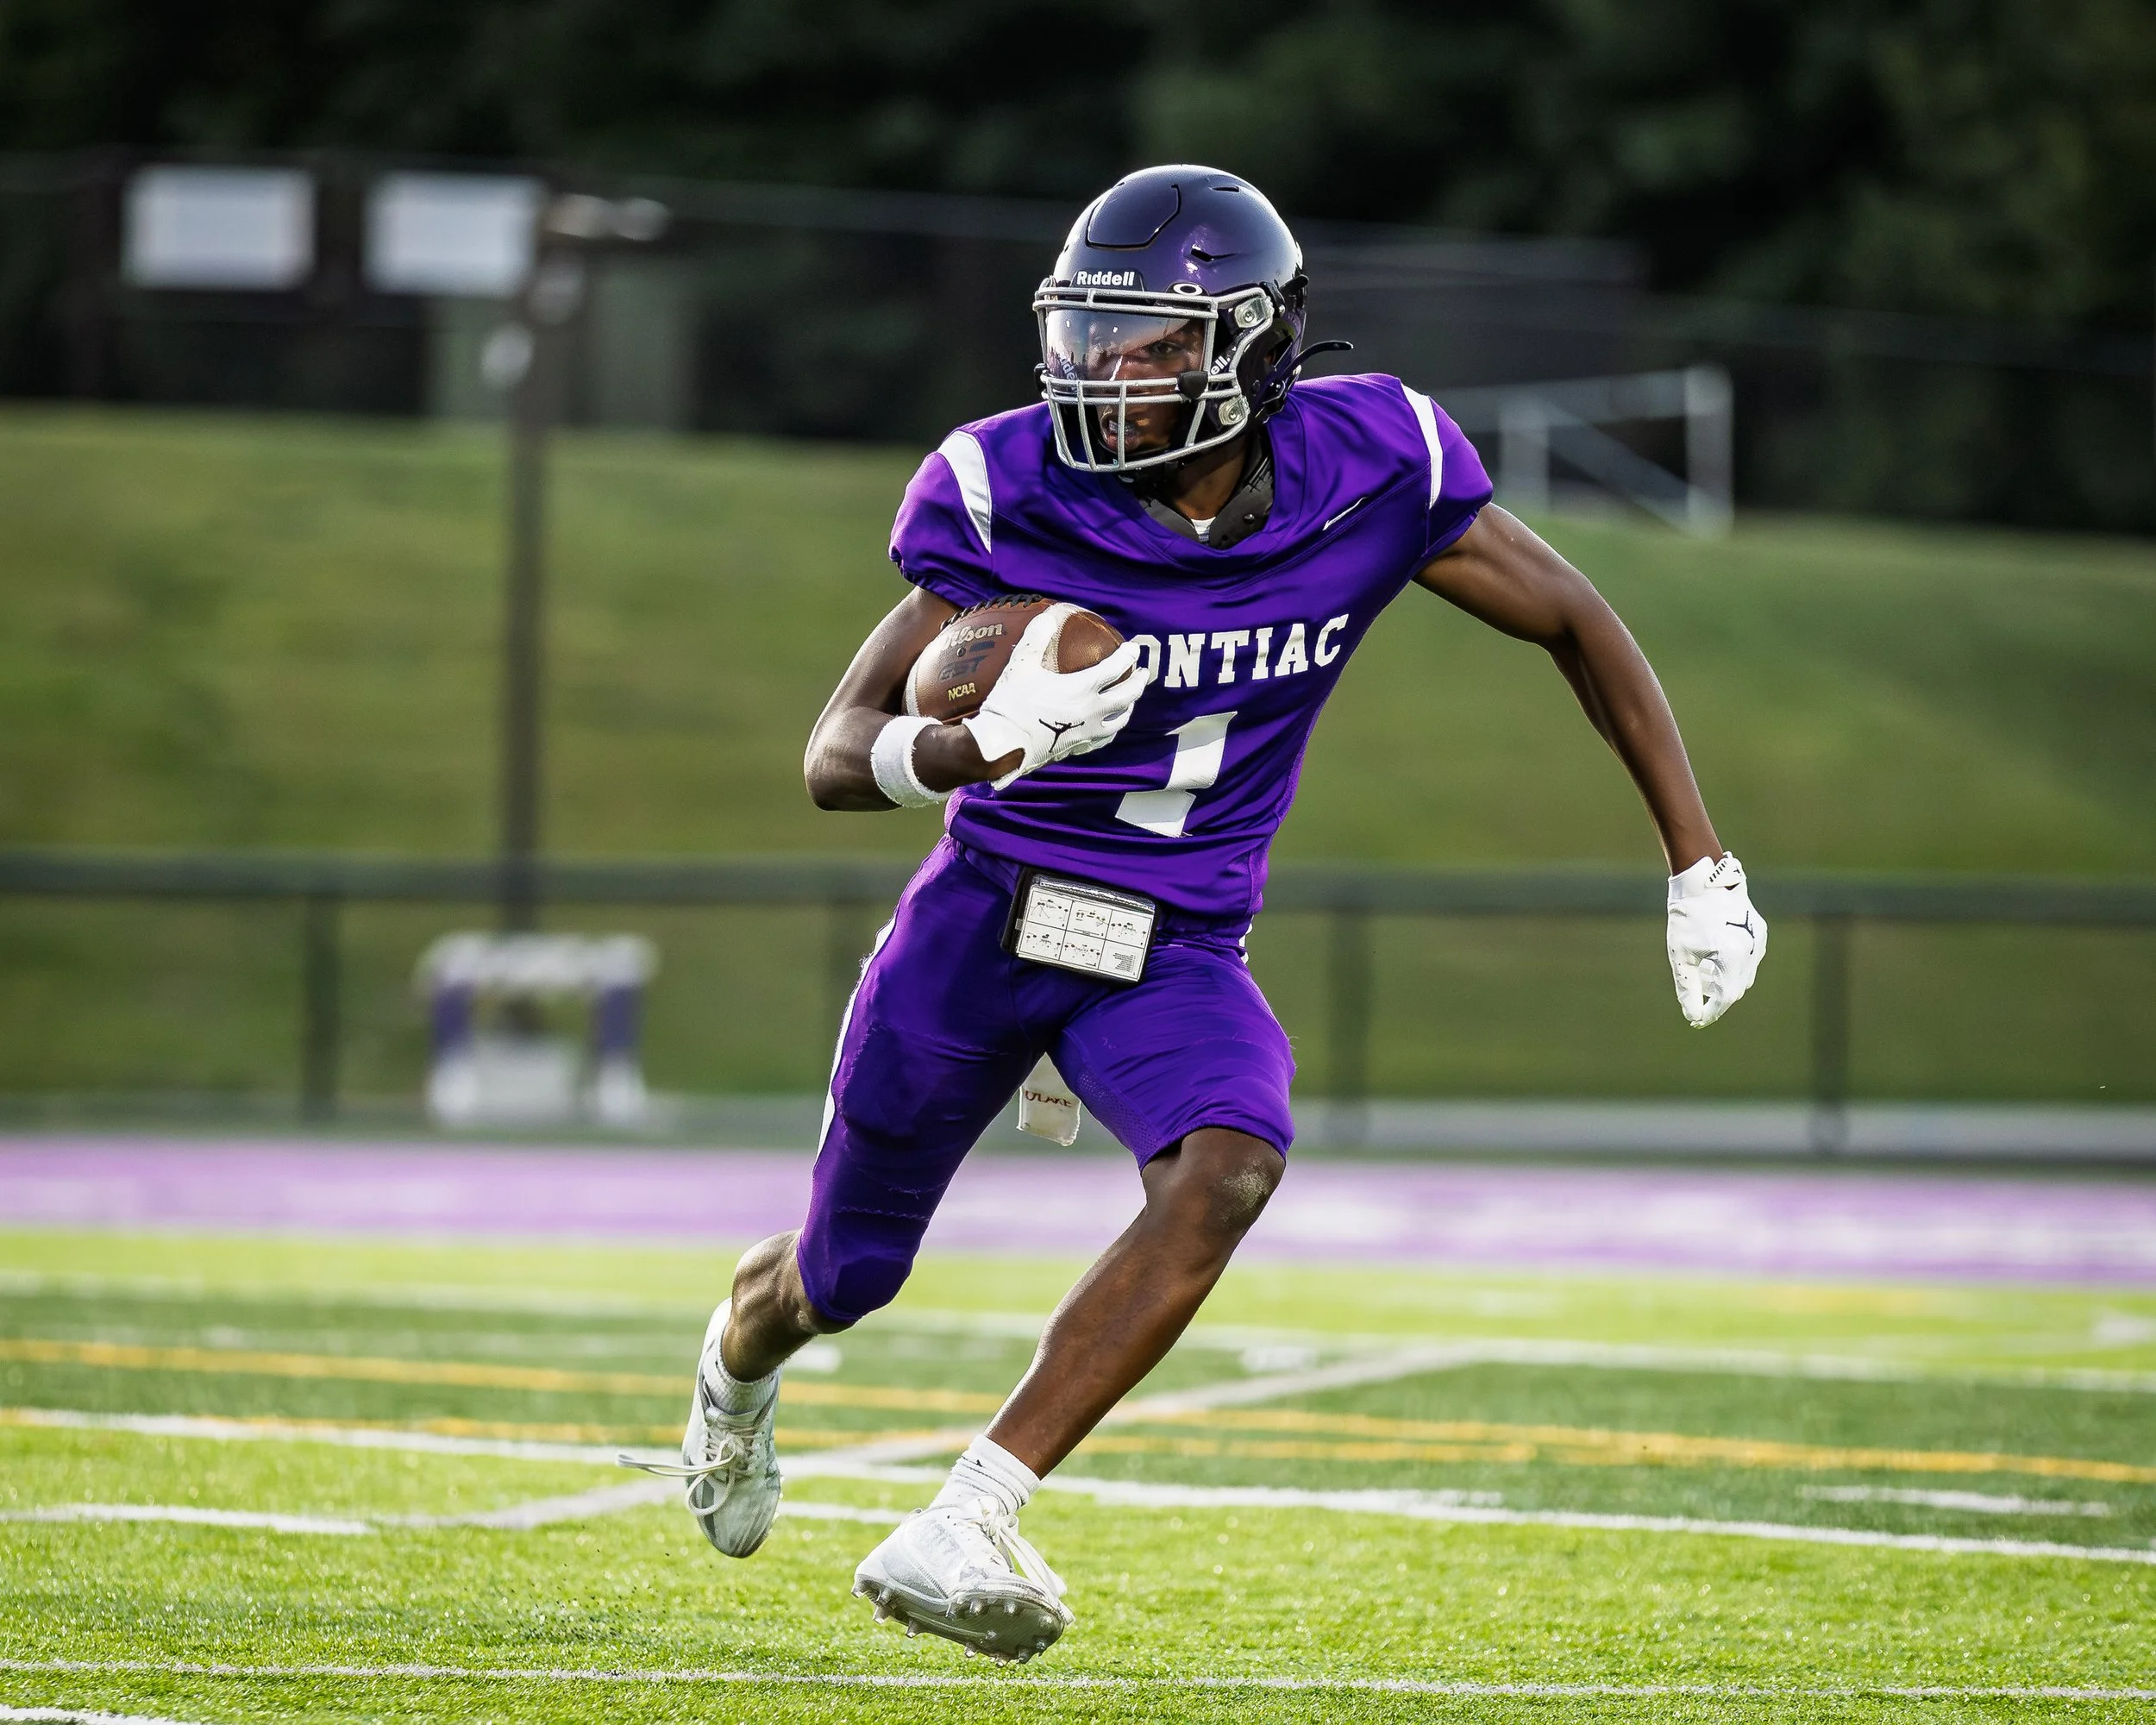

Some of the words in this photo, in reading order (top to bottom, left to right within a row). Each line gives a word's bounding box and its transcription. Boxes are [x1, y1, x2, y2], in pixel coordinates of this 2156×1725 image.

[1077, 270, 1136, 286] Riddell
[945, 624, 1004, 649] ilson
[1127, 614, 1349, 688] ONTIAC
[948, 682, 977, 702] NCAA
[1115, 711, 1238, 838] 1
